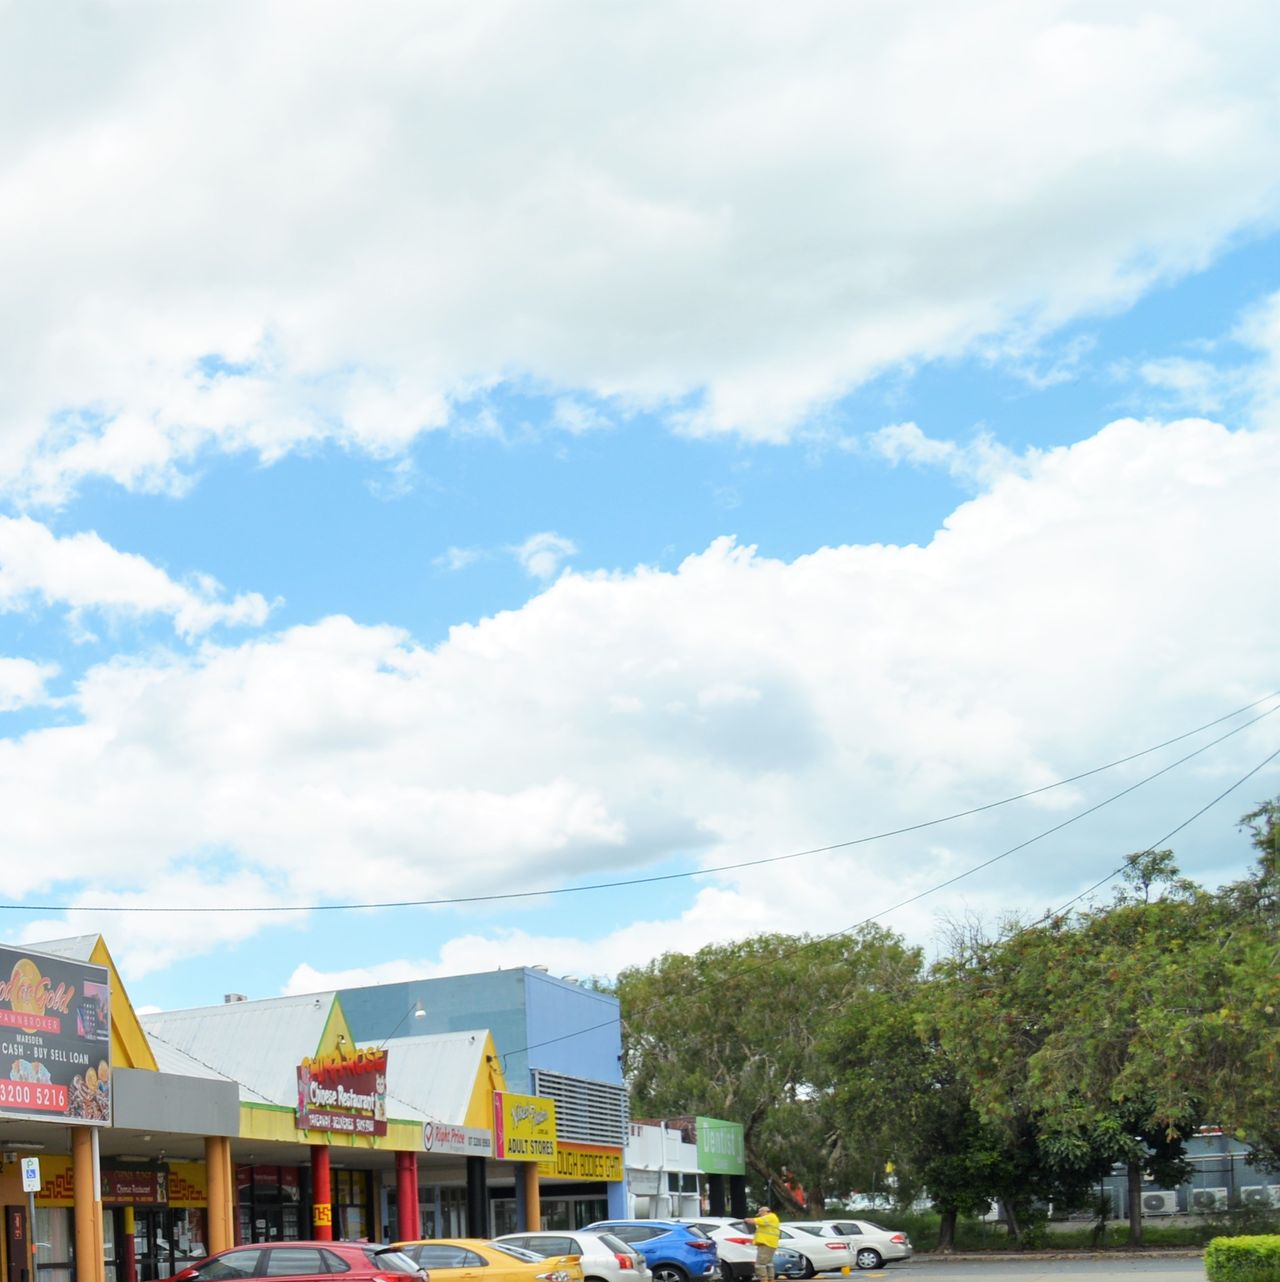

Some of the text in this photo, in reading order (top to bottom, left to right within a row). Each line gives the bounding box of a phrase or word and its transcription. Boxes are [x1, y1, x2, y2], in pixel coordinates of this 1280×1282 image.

[33, 975, 76, 1014] Gold
[16, 1034, 43, 1045] MARSDEN
[2, 1042, 24, 1056] CASH
[34, 1047, 48, 1060] BUY
[50, 1049, 67, 1062] SELL
[69, 1051, 89, 1065] LOAN
[0, 1084, 65, 1106] 3200 5216
[450, 1128, 465, 1145] Price
[508, 1138, 528, 1154] ADULT
[530, 1139, 554, 1155] STORES
